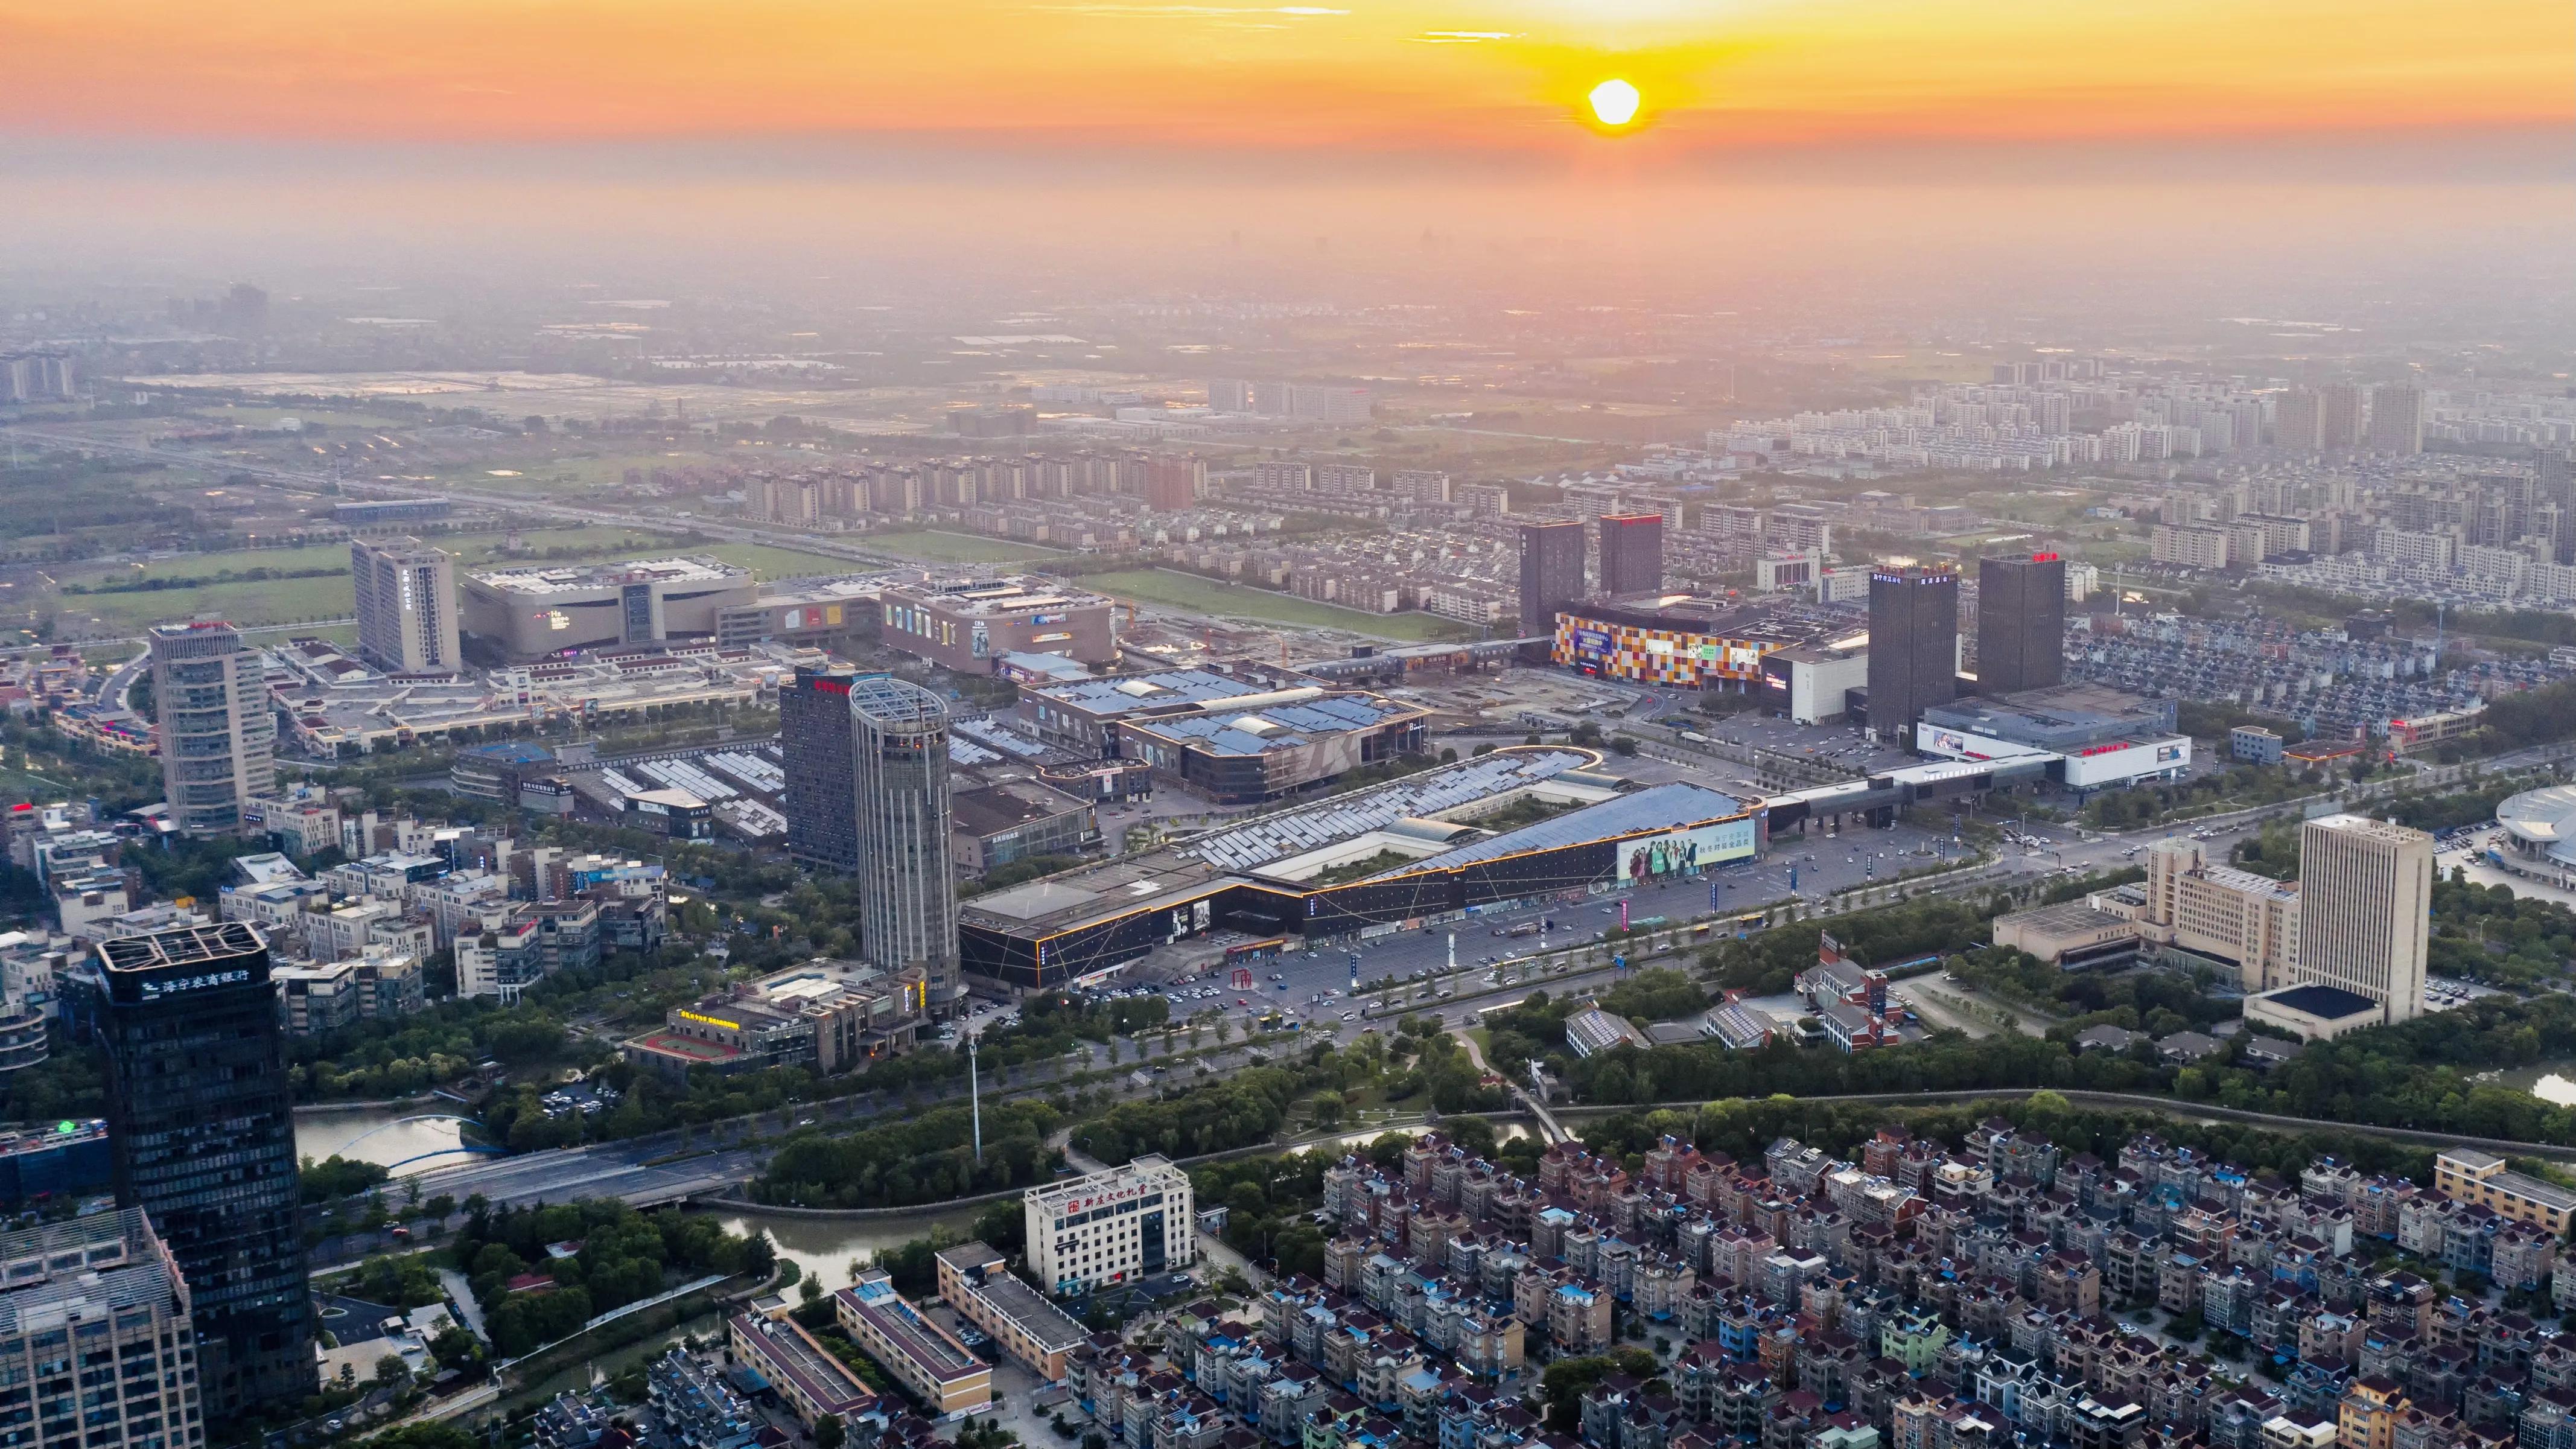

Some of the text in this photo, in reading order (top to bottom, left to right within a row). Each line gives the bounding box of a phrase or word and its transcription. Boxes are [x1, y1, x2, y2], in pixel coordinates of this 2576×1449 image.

[163, 970, 249, 993] 海宁农商银行
